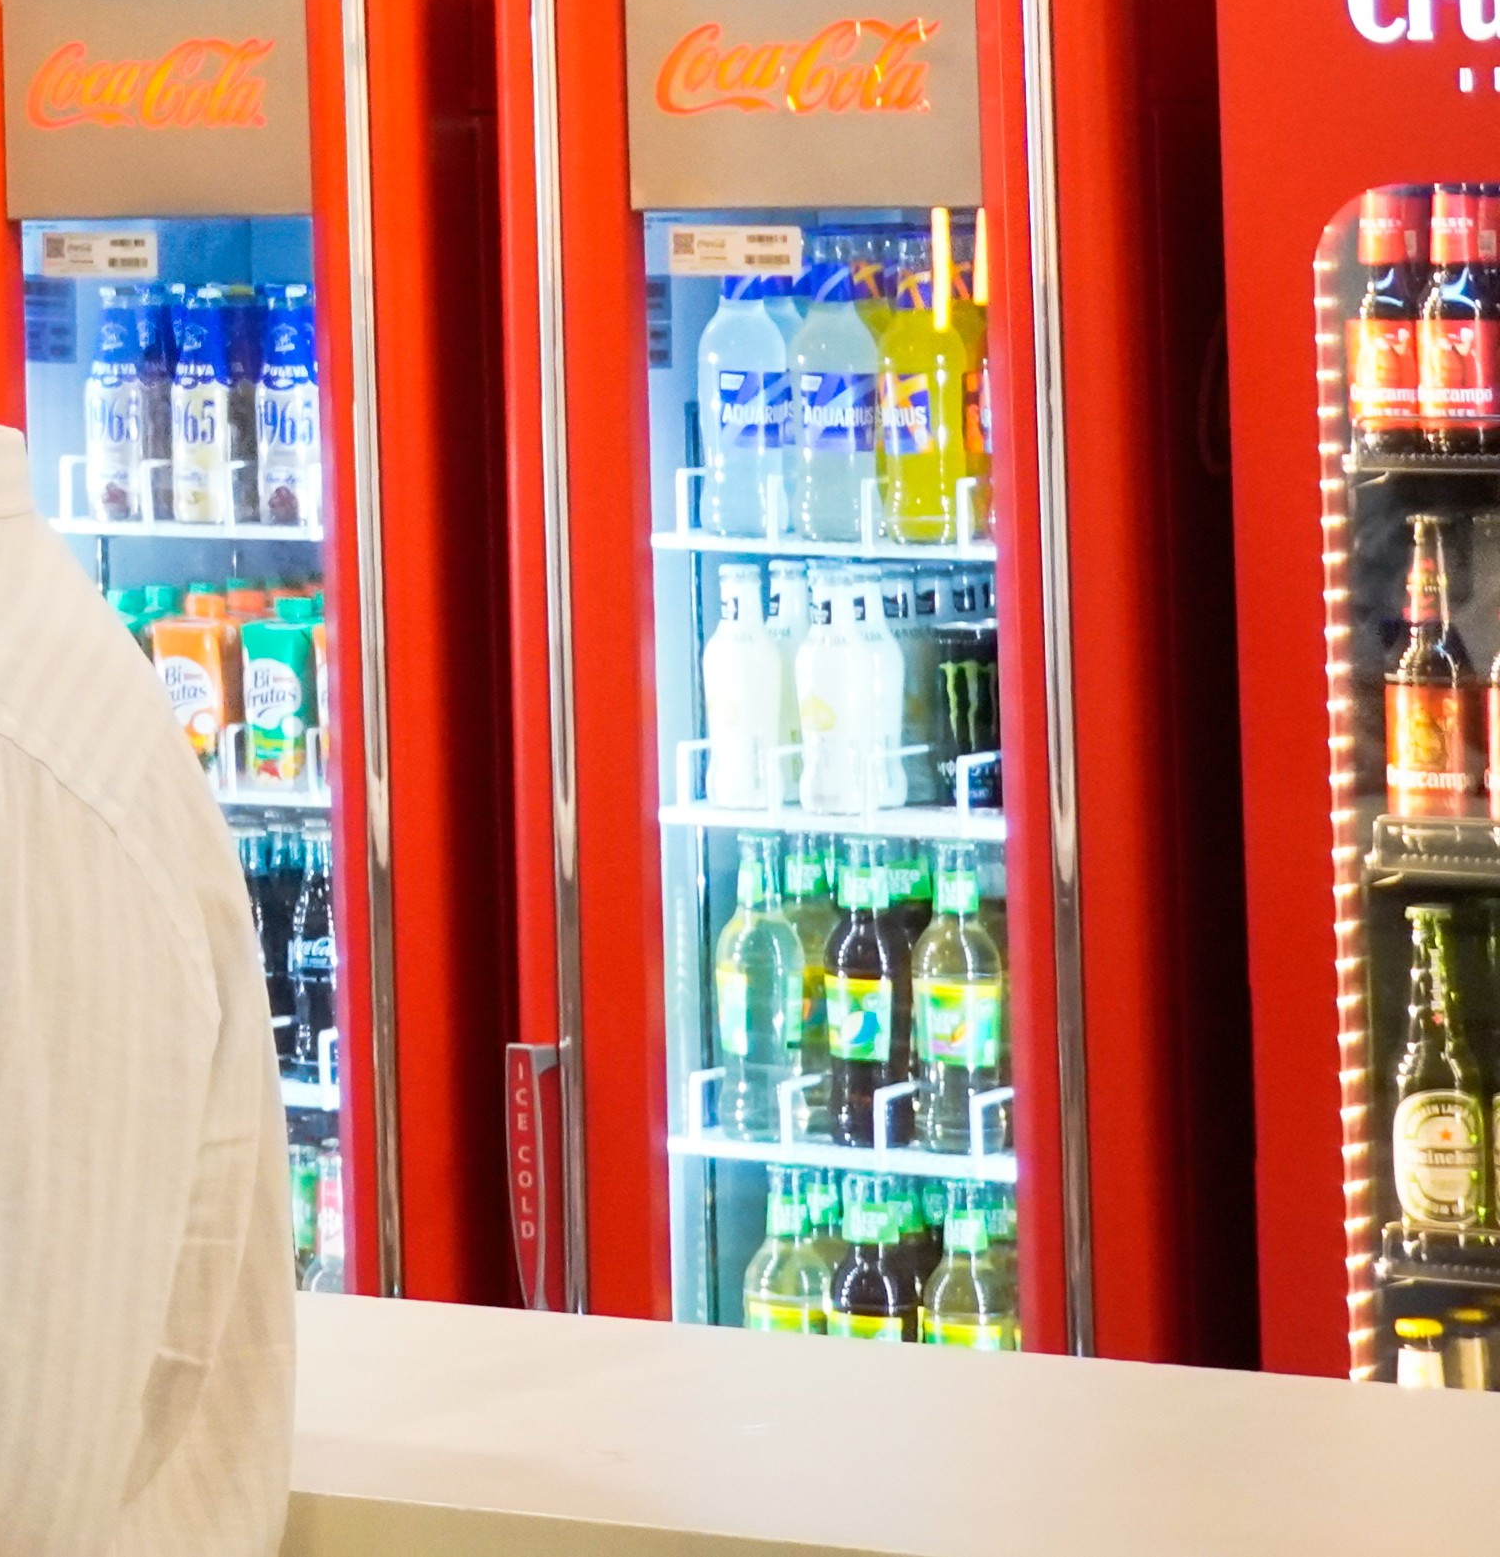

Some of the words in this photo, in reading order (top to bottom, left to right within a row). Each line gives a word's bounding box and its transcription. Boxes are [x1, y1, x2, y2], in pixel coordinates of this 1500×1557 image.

[655, 18, 940, 116] Coca-Cola
[26, 36, 277, 130] Coca-Cola
[263, 364, 308, 378] PULEVA
[166, 665, 182, 686] Bi
[253, 668, 270, 689] Bi
[171, 684, 207, 700] utas
[247, 685, 297, 711] frutas
[515, 1062, 528, 1132] ICE
[1402, 1149, 1478, 1167] eineken
[517, 1145, 536, 1240] COLD
